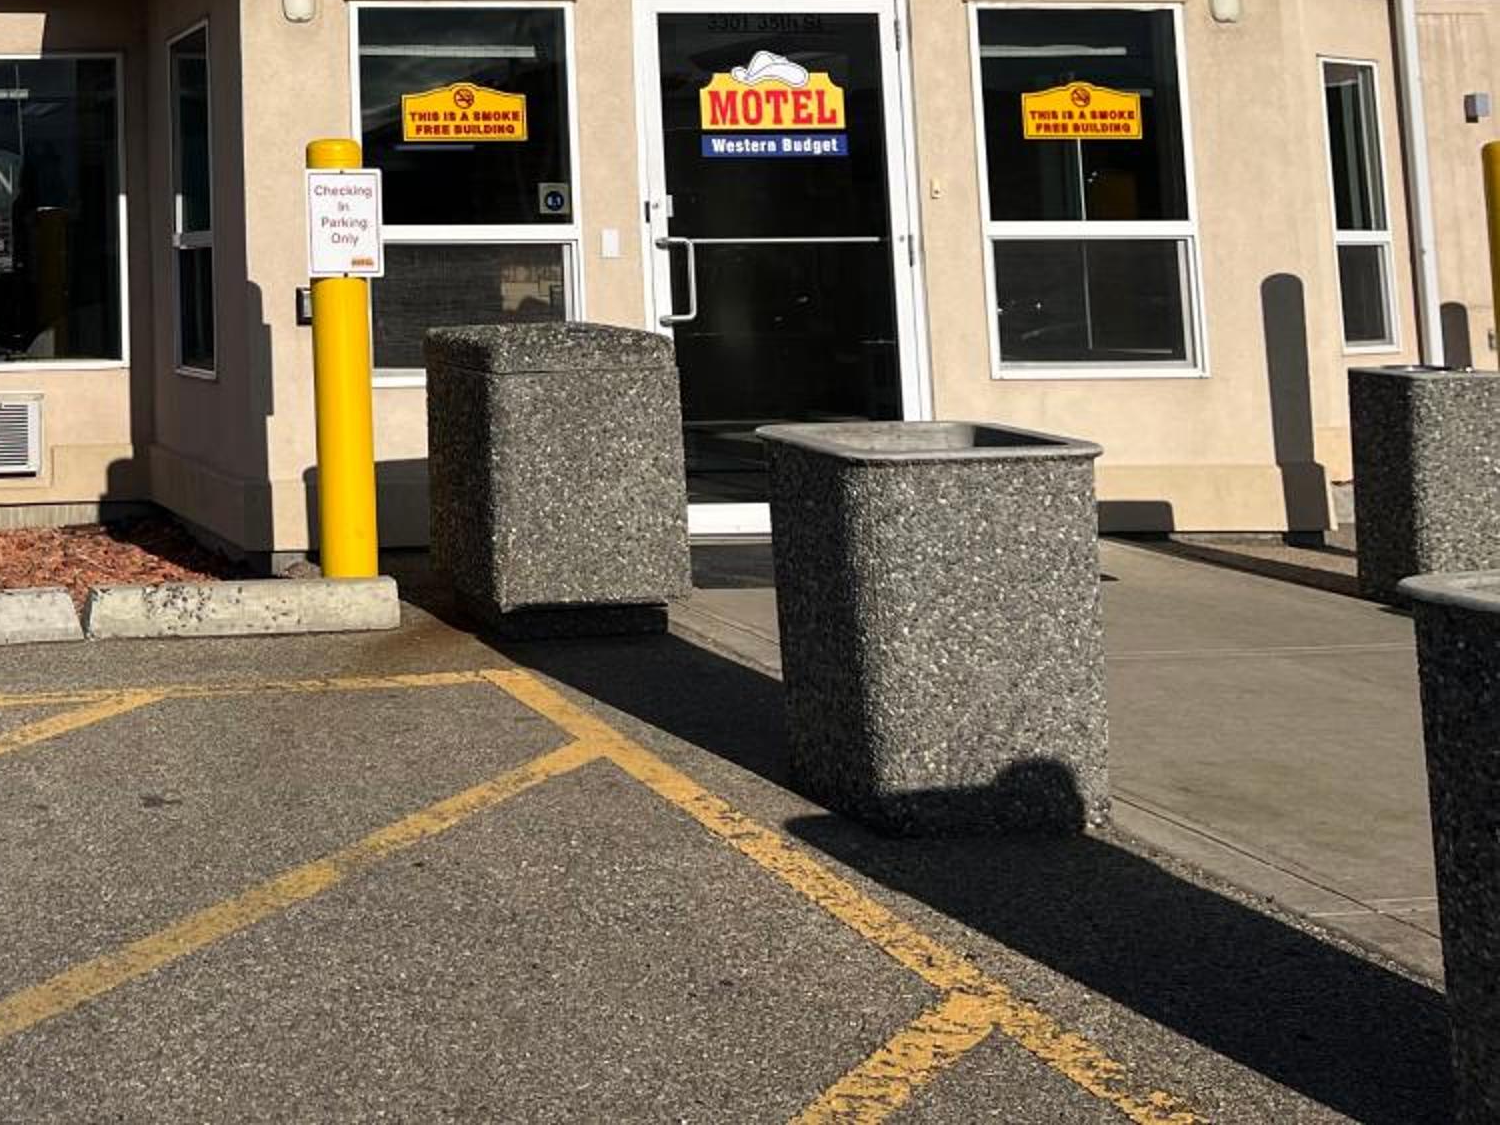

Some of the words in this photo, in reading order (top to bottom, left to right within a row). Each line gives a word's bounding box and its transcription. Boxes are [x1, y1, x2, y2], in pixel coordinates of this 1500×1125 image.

[708, 89, 838, 125] MOTEL
[410, 111, 439, 122] THIS
[443, 111, 456, 122] IS
[460, 111, 469, 122] A
[473, 111, 520, 122] SMOKE
[1029, 110, 1058, 120] THIS
[1061, 110, 1073, 120] IS
[1077, 110, 1086, 120] A
[1090, 110, 1135, 120] SMOKE
[415, 124, 450, 135] FREE
[454, 124, 515, 135] BUILDING
[1035, 122, 1068, 133] FREE
[1072, 122, 1131, 133] BUILDING
[711, 138, 777, 152] Western
[782, 138, 839, 154] Budget
[313, 184, 372, 200] Checking
[321, 216, 368, 231] Parking
[331, 232, 359, 247] Only
